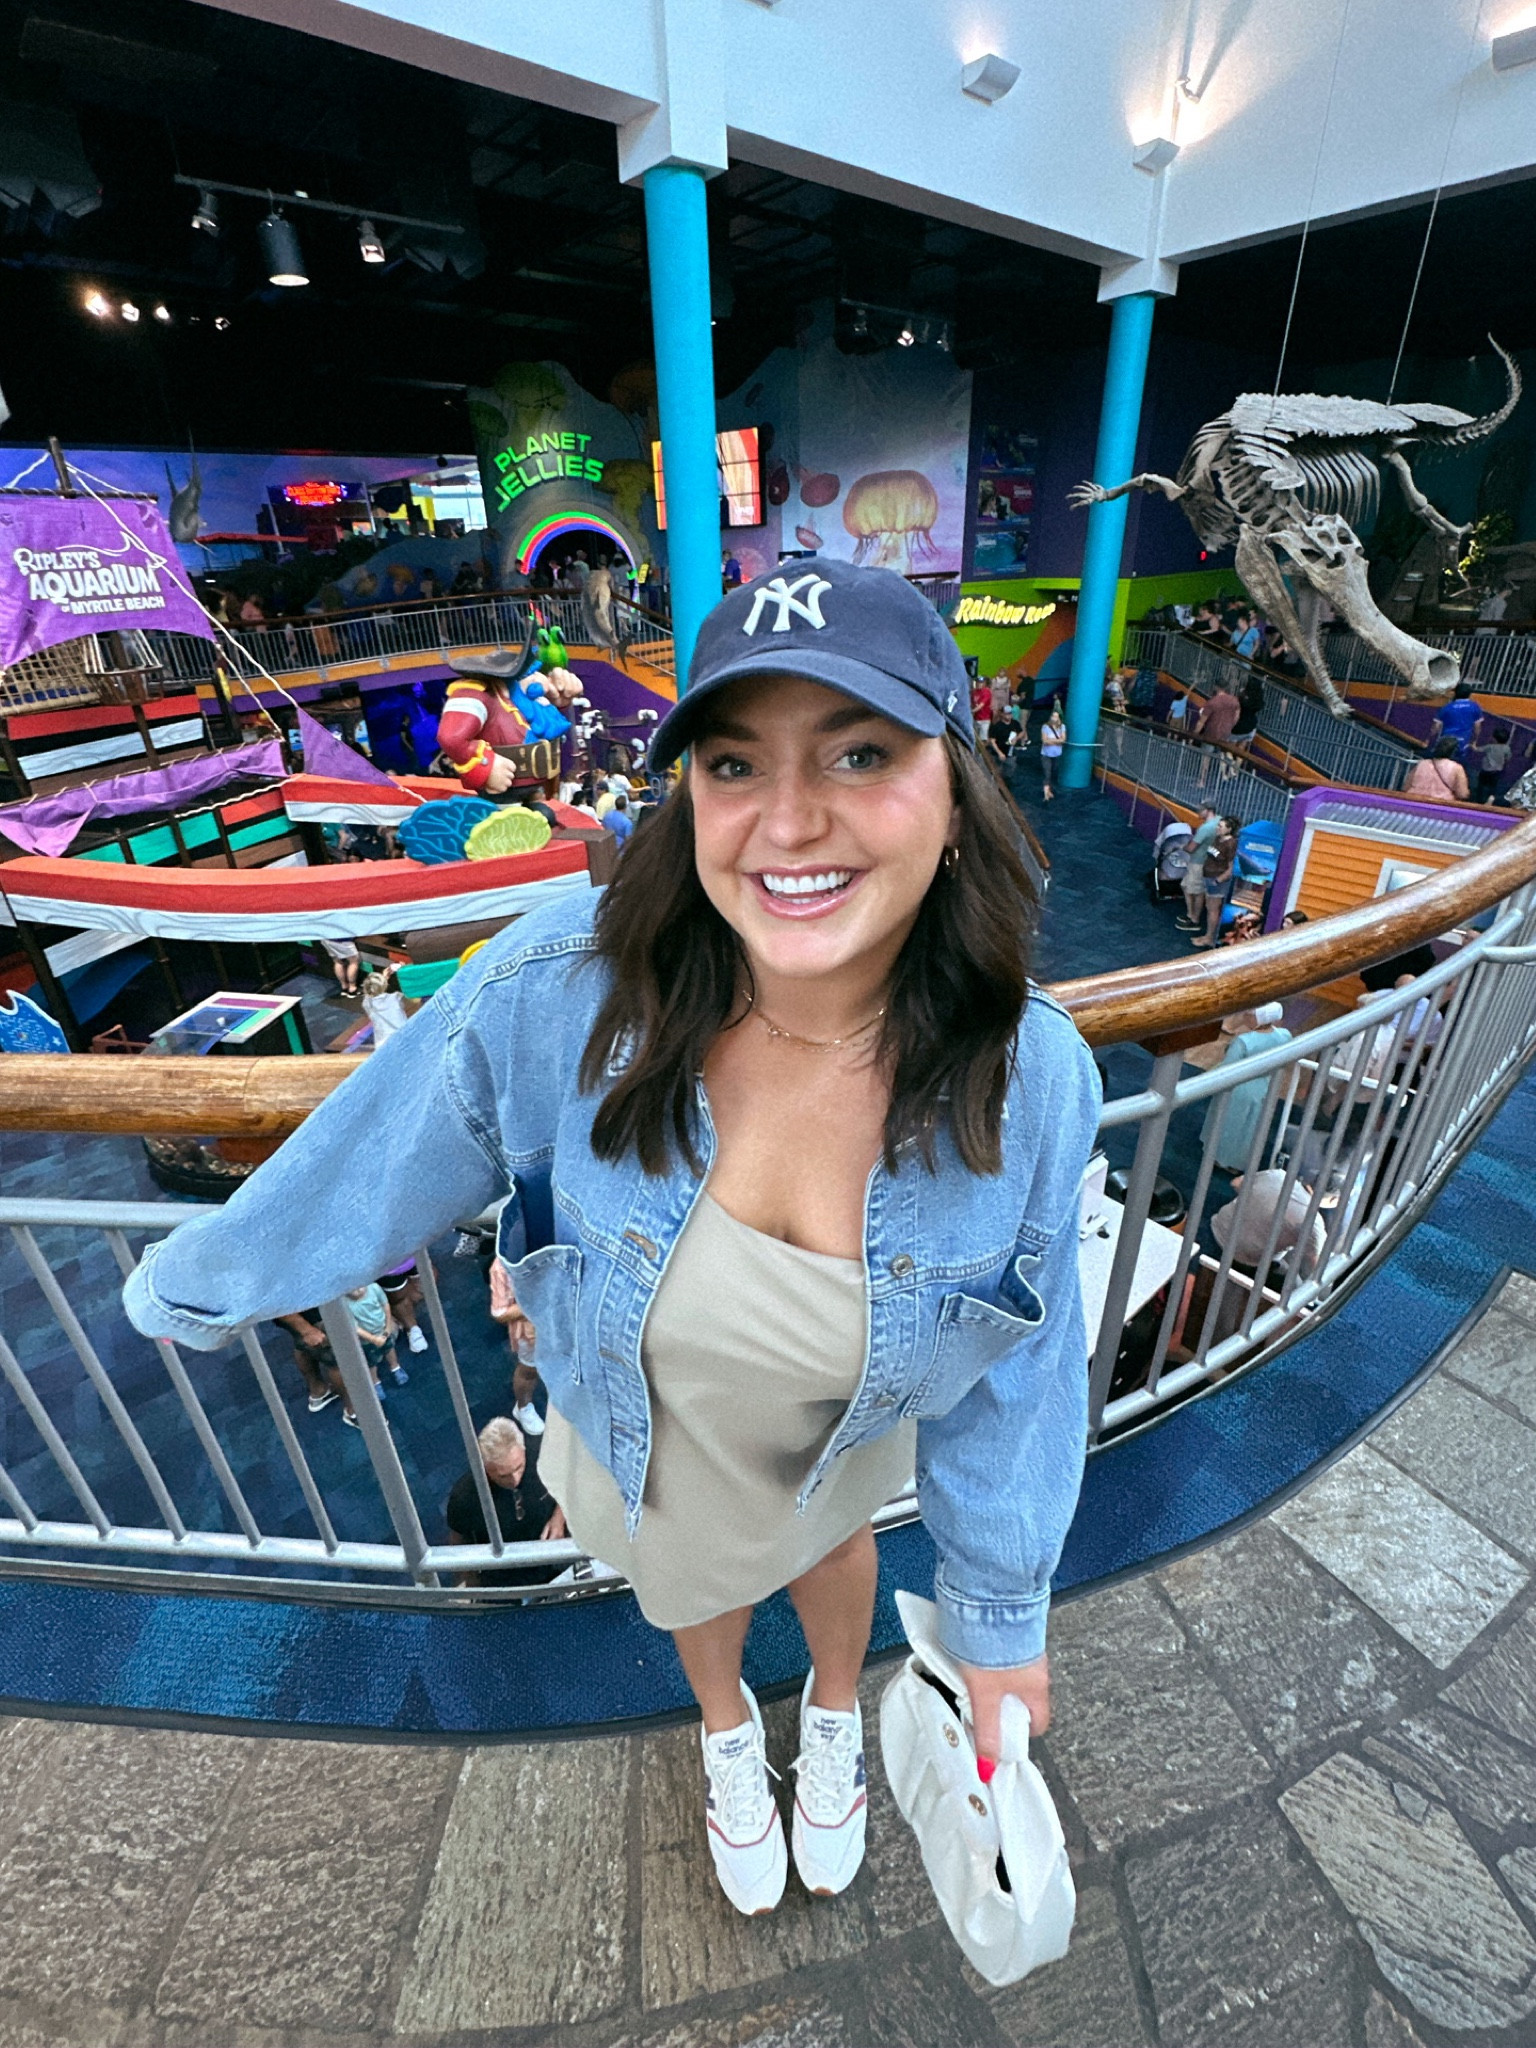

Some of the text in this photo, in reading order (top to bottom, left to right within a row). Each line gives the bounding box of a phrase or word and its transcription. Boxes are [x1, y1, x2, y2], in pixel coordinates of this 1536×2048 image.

[493, 432, 592, 473] PLANET
[495, 454, 604, 513] JELLIES
[14, 547, 101, 576] RIPLEY'S
[29, 563, 161, 605] AQUARIUM
[70, 598, 126, 615] MYRTLE
[125, 596, 165, 610] BEACH
[742, 573, 833, 637] NY
